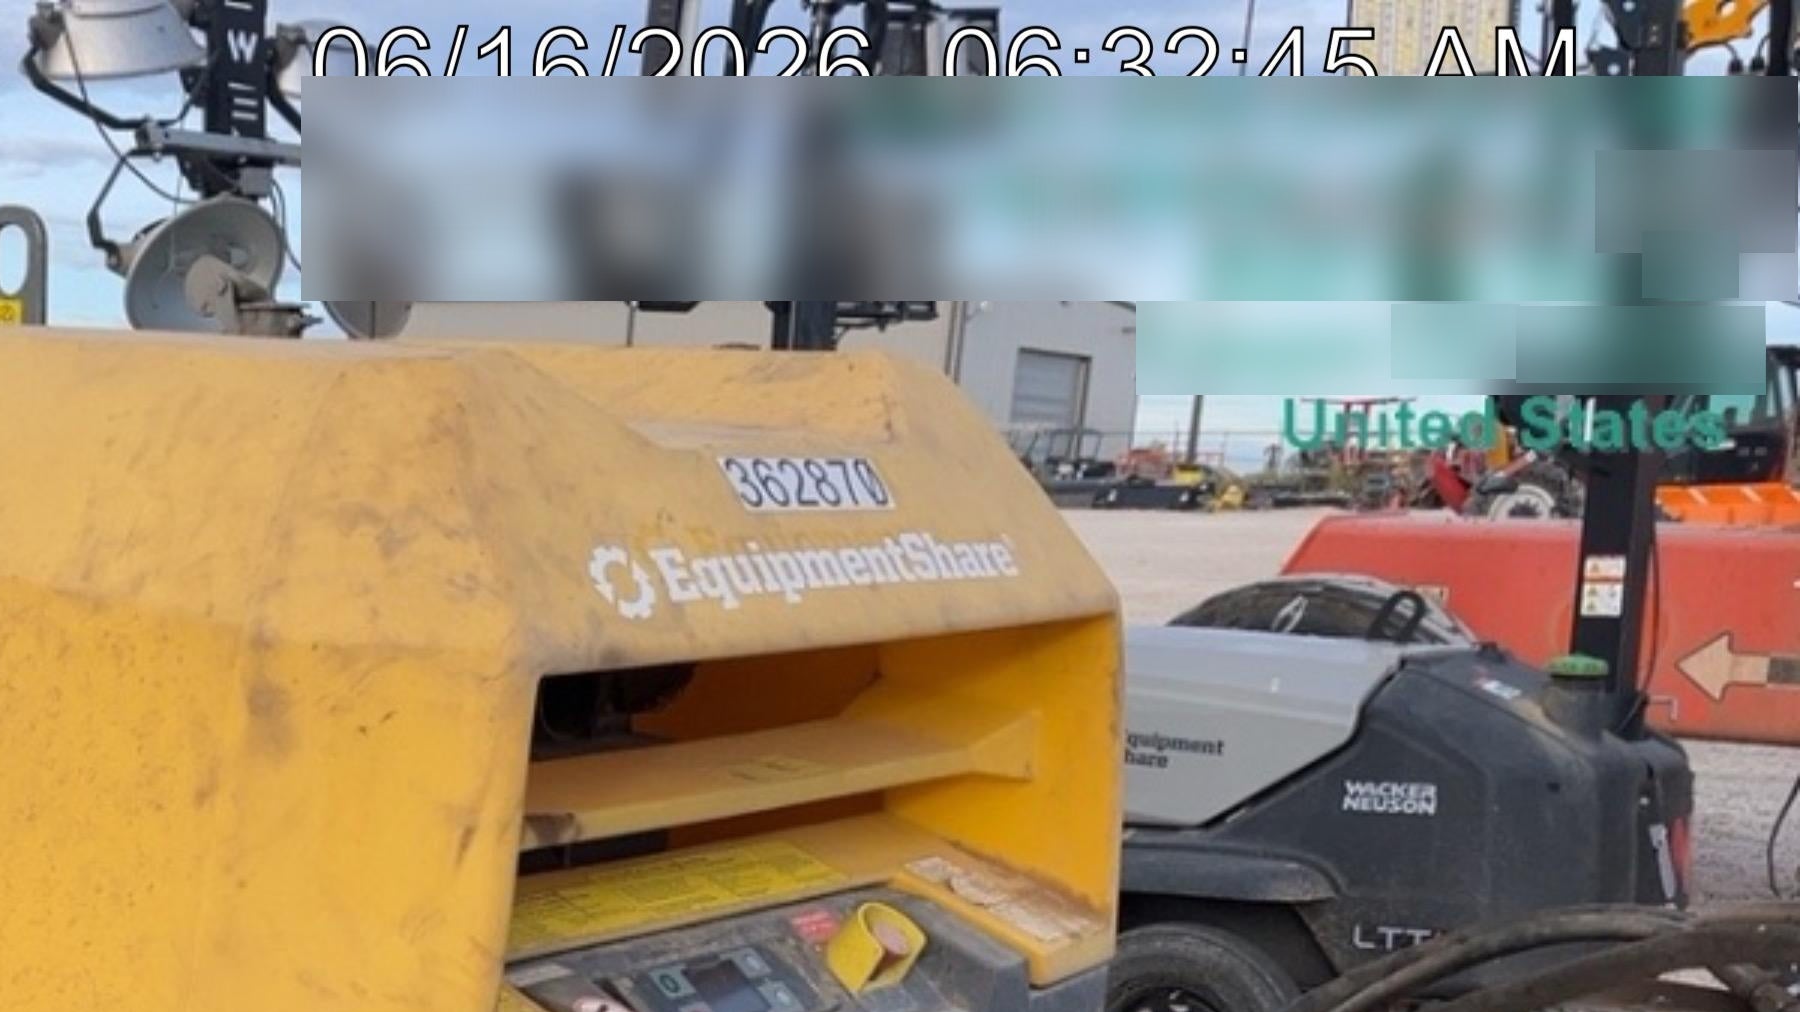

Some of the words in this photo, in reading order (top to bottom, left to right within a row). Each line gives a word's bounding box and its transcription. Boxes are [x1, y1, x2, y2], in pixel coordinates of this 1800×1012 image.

[721, 457, 891, 509] 362870
[650, 531, 1018, 611] EquipmentShare
[1124, 730, 1225, 756] quipment
[1123, 748, 1169, 768] hare
[1344, 779, 1438, 799] WACKER
[1342, 796, 1437, 816] NEUSON
